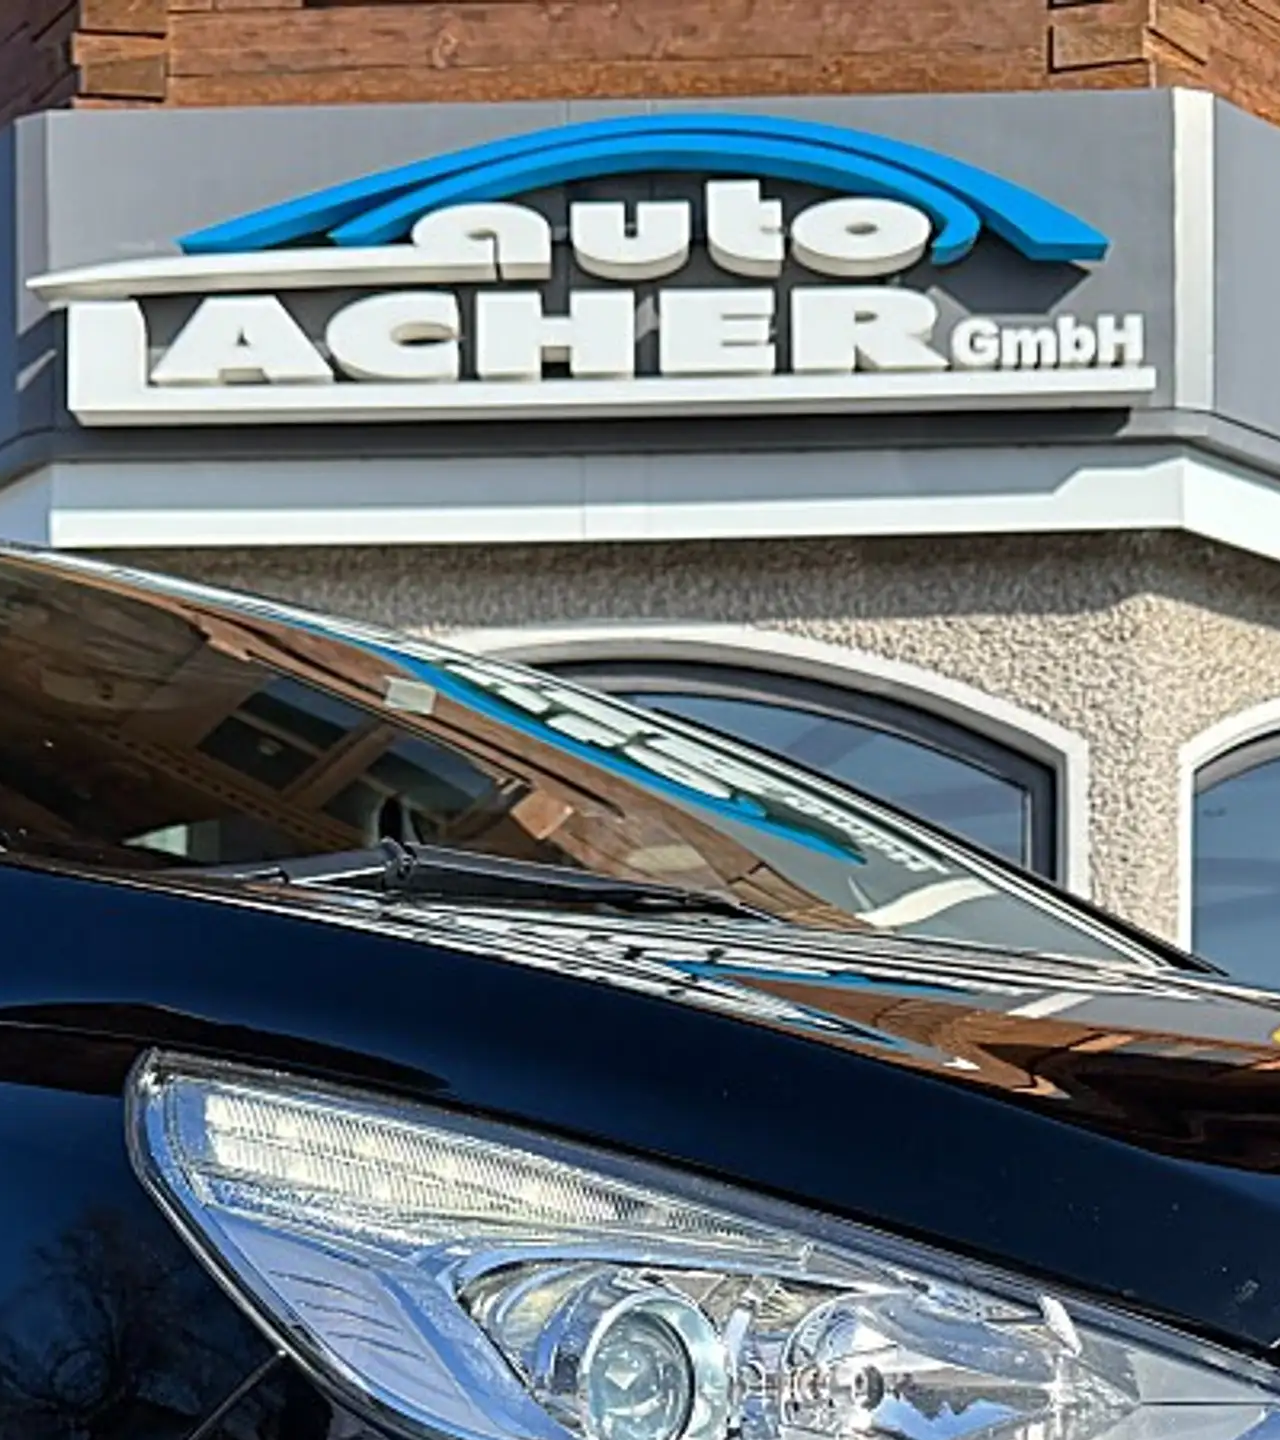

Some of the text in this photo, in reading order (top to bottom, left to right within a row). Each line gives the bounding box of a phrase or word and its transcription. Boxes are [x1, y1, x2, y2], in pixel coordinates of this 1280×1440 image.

[412, 178, 932, 280] auto
[66, 284, 1144, 426] LACHER GmbH
